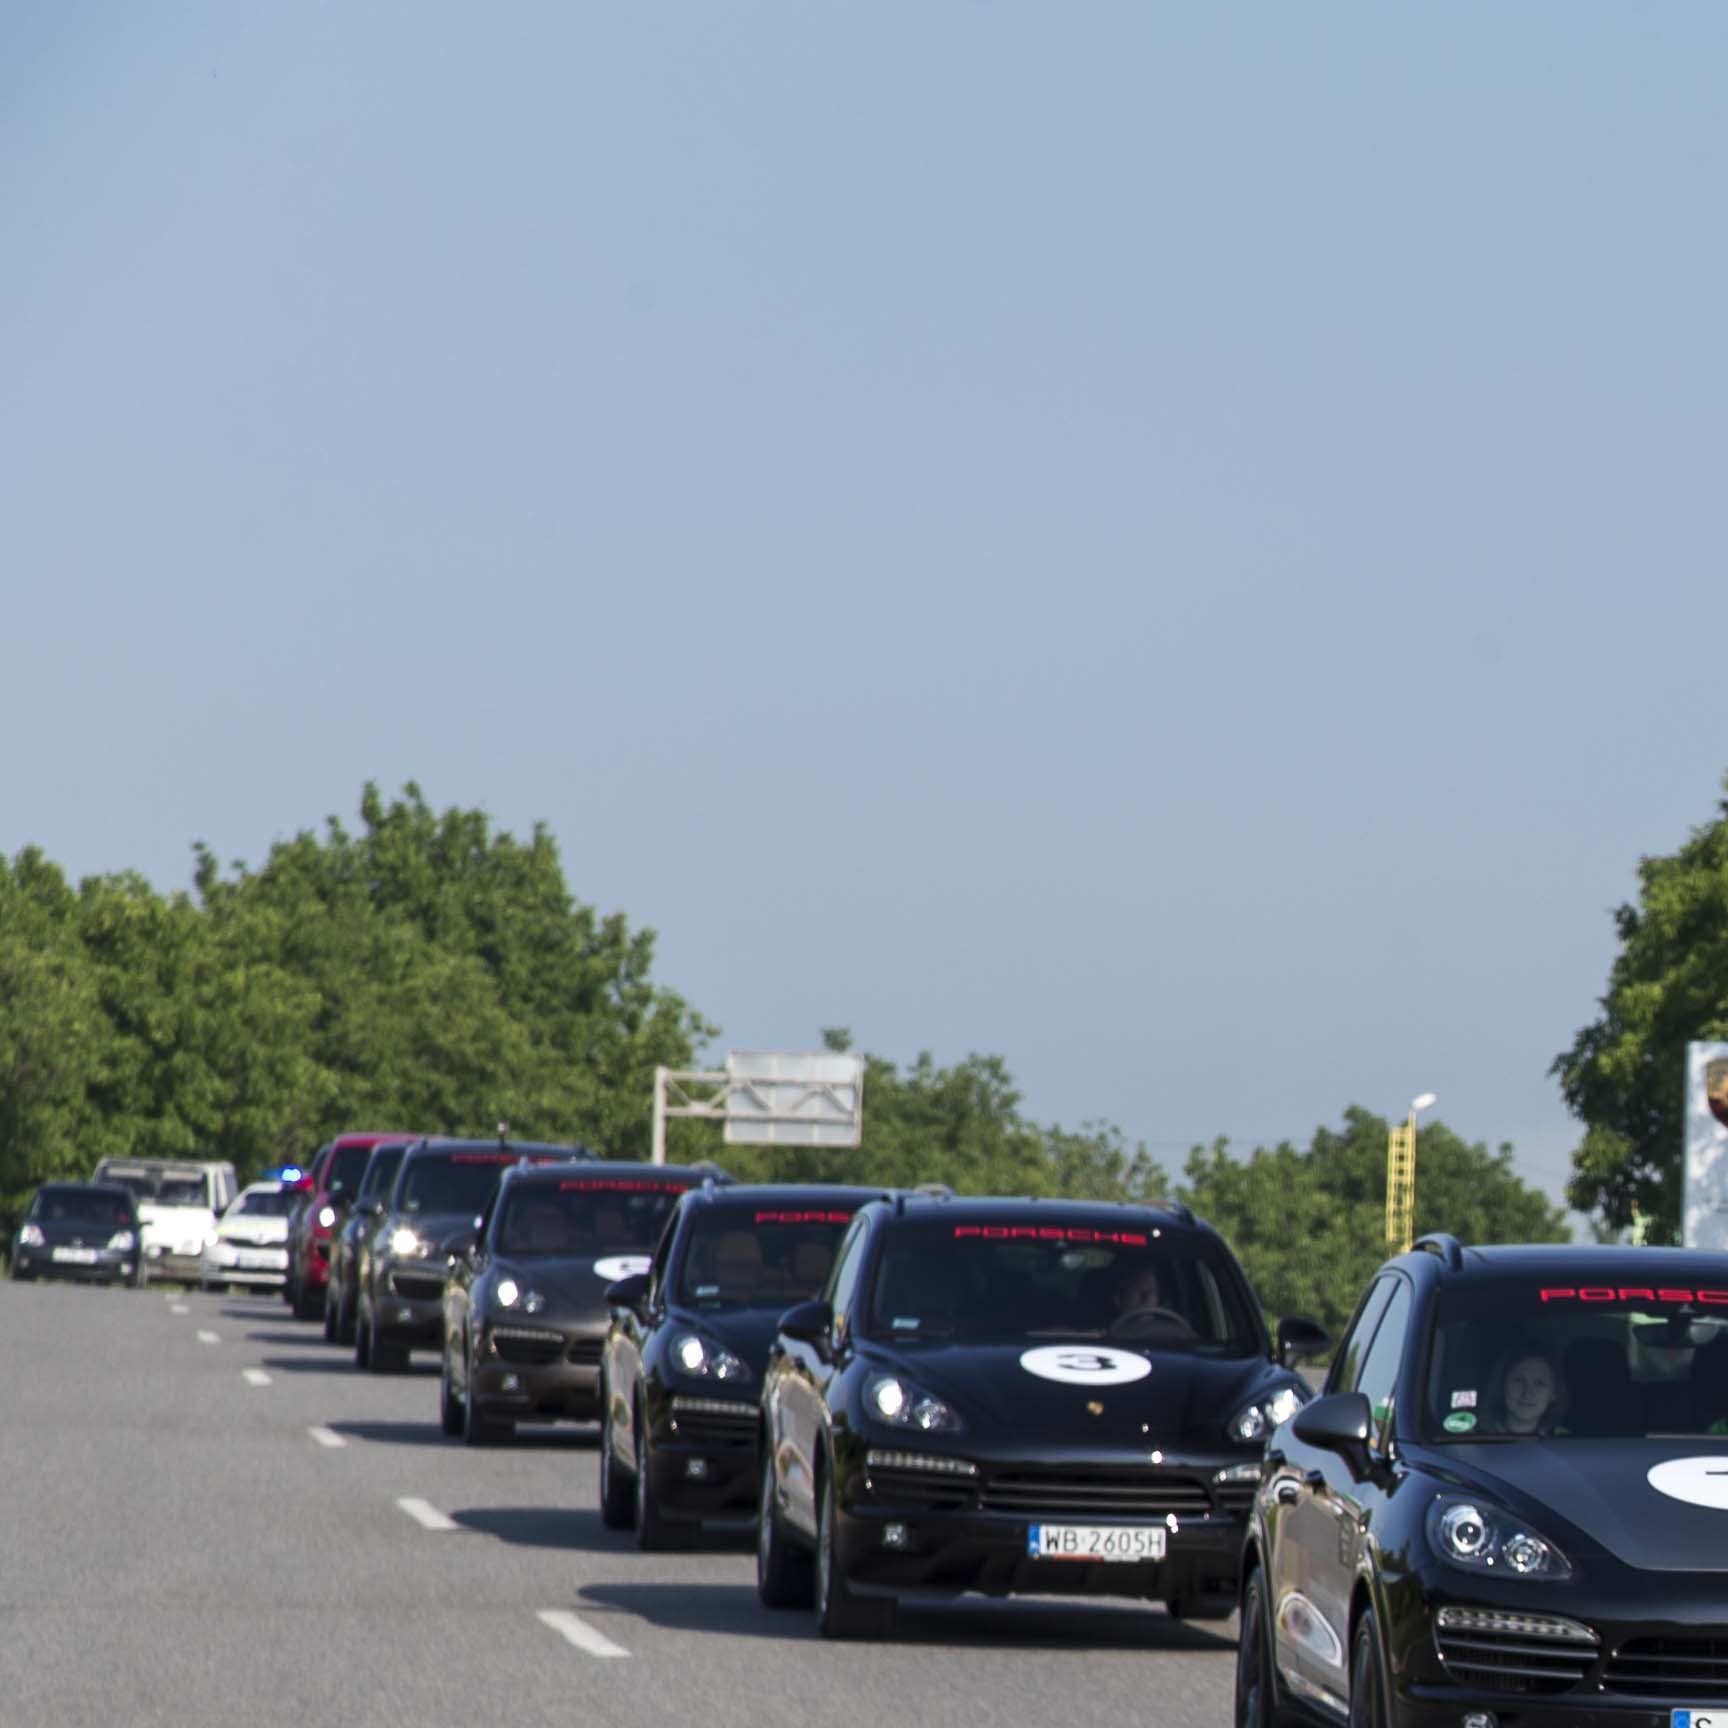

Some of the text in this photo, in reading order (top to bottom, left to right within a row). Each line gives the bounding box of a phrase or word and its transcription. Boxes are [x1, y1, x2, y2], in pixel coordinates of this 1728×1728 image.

[755, 1211, 849, 1225] PORS
[955, 1226, 1148, 1245] PORSCHE
[1058, 1354, 1118, 1372] 3
[1046, 1529, 1079, 1552] WB
[1088, 1530, 1162, 1554] 2605H
